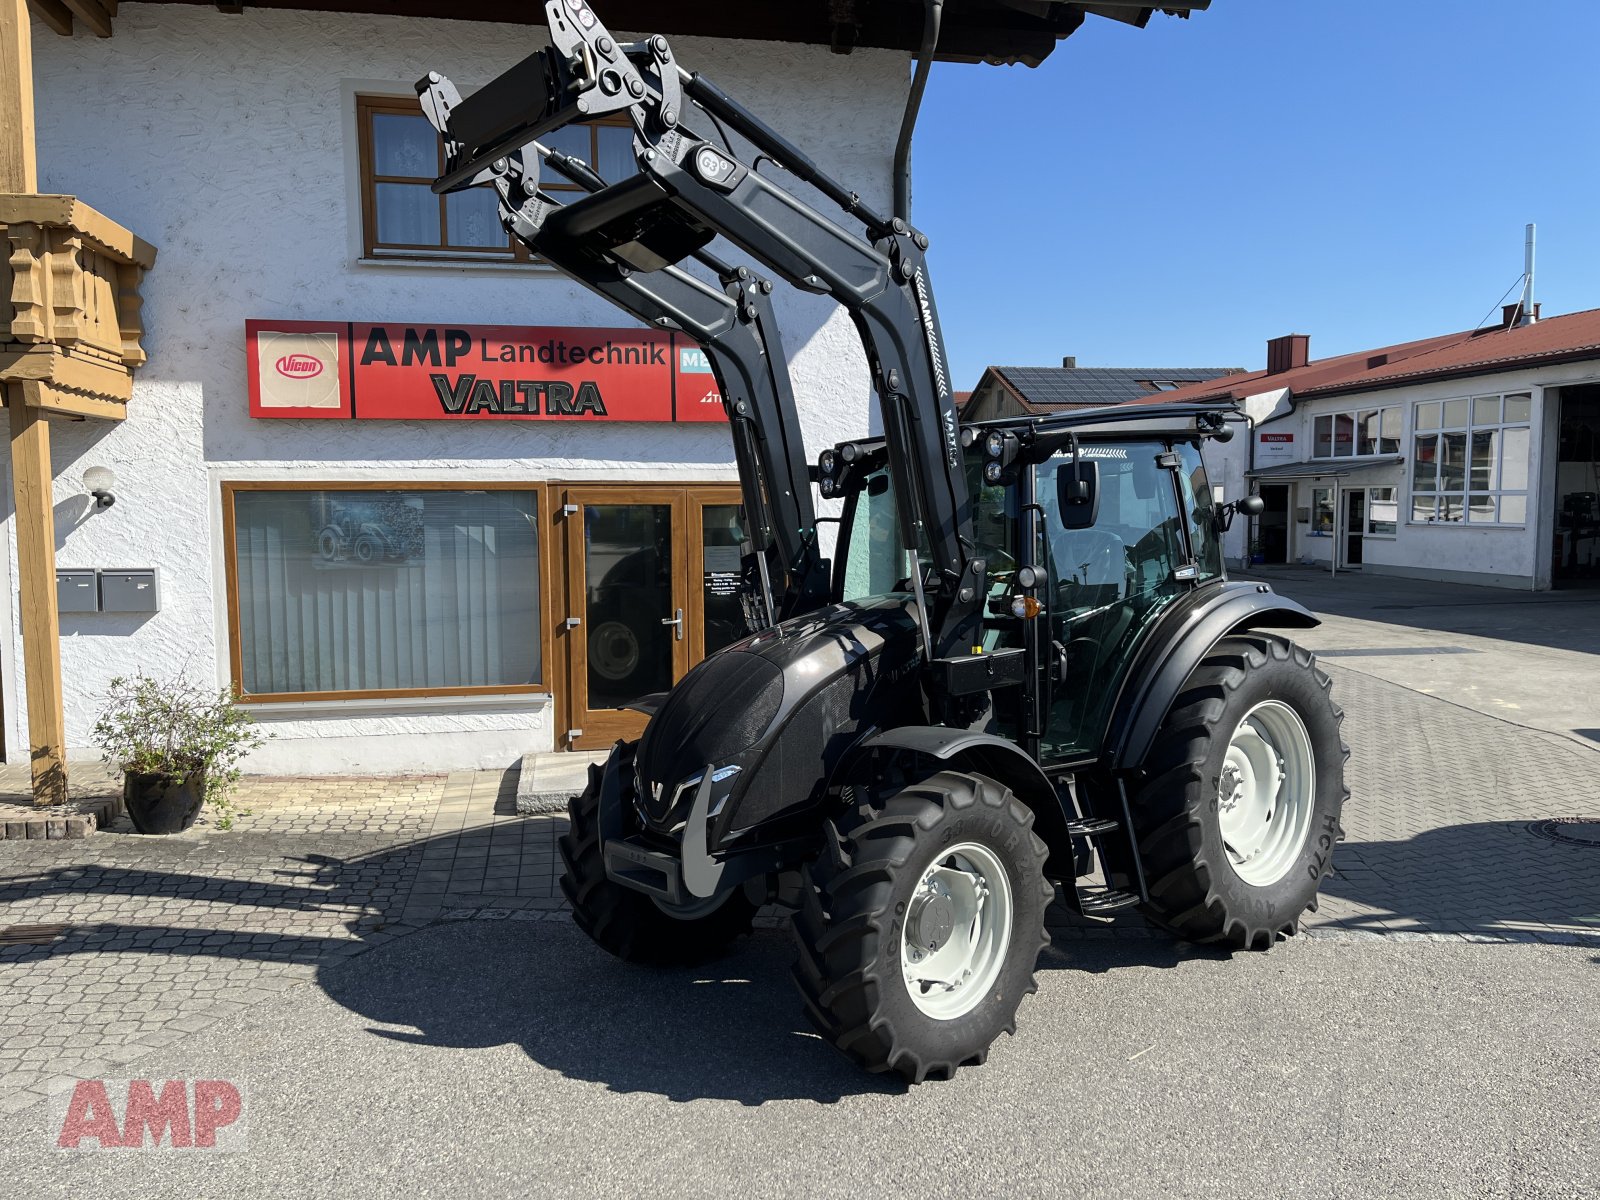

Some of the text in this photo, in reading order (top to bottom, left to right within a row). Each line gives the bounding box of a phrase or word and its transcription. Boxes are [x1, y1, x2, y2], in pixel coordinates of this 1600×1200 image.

[280, 354, 318, 373] Vicon
[360, 327, 666, 367] AMP Landtechnik
[429, 374, 608, 416] VALTRA
[1307, 814, 1336, 881] HC70
